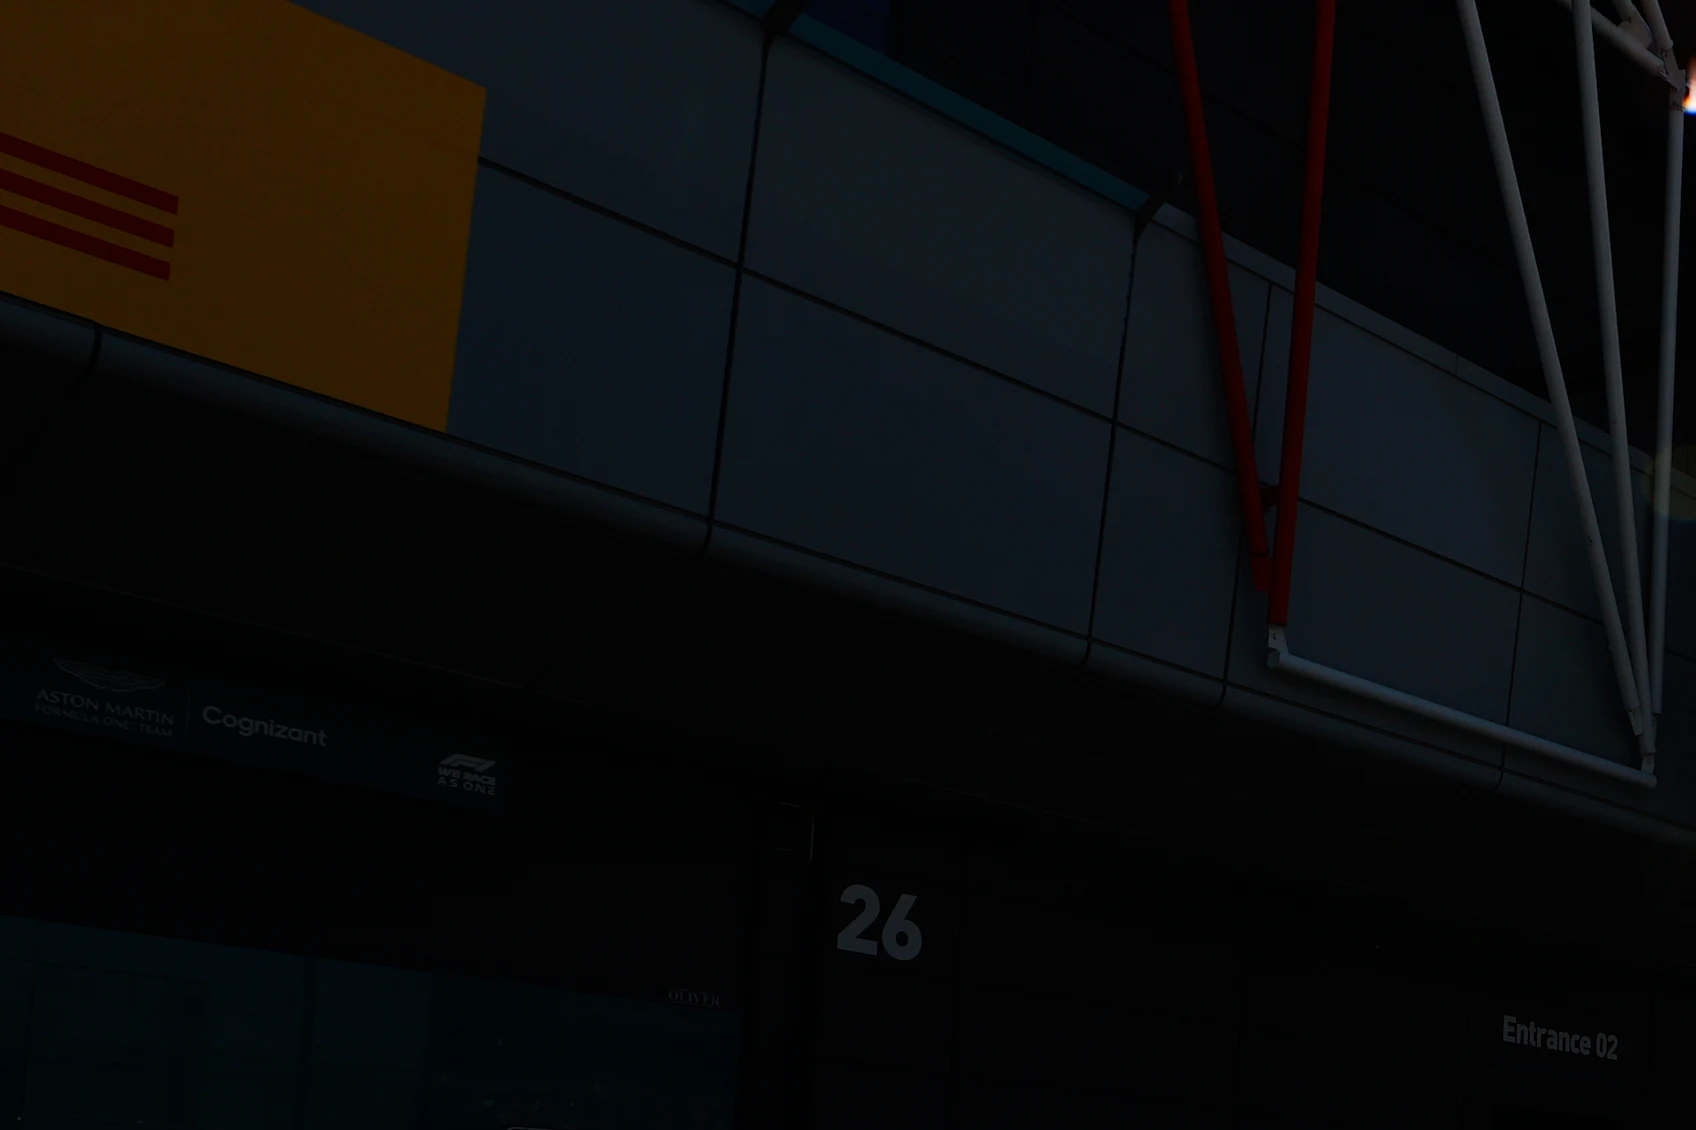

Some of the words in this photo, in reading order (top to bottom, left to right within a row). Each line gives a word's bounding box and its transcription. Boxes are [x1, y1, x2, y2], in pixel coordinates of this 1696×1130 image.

[34, 702, 99, 725] FORMULA
[103, 716, 131, 730] ONE
[138, 723, 173, 737] TEAM
[36, 688, 99, 711] ASTON
[105, 701, 174, 725] MARTIN
[201, 705, 328, 747] Cognizant
[437, 776, 458, 788] AS
[463, 781, 497, 796] ONE
[438, 766, 461, 779] WE
[836, 882, 924, 961] 26
[668, 989, 721, 1007] OLIVER
[1502, 1015, 1592, 1056] Entrance
[1595, 1032, 1619, 1061] 02
